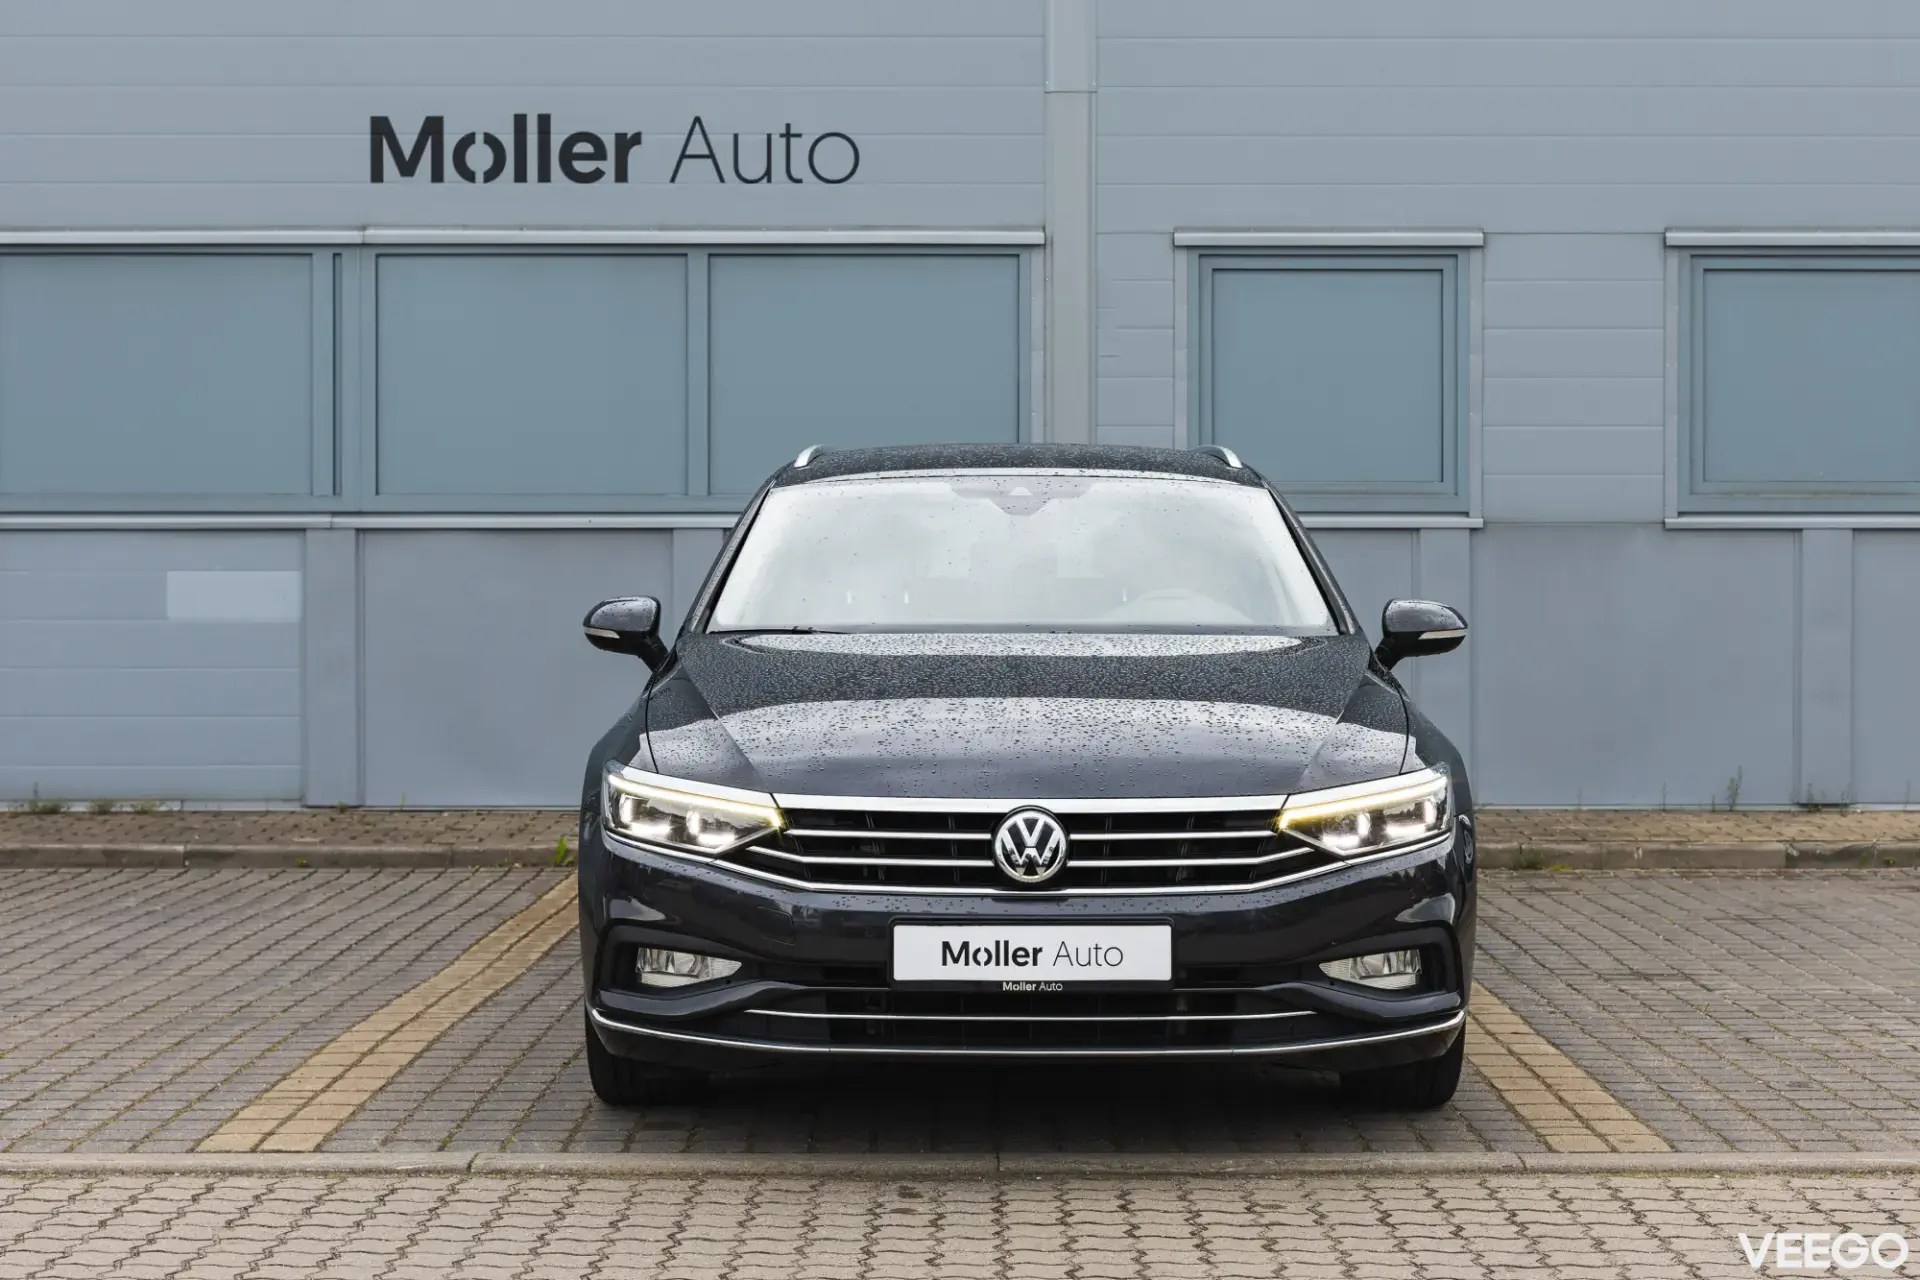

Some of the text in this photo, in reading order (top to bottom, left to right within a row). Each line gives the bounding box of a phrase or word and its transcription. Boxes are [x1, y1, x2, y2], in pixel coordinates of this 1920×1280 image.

[669, 115, 861, 184] Auto
[998, 811, 1066, 882] VW
[1052, 941, 1124, 967] Auto
[1038, 981, 1064, 992] Auto
